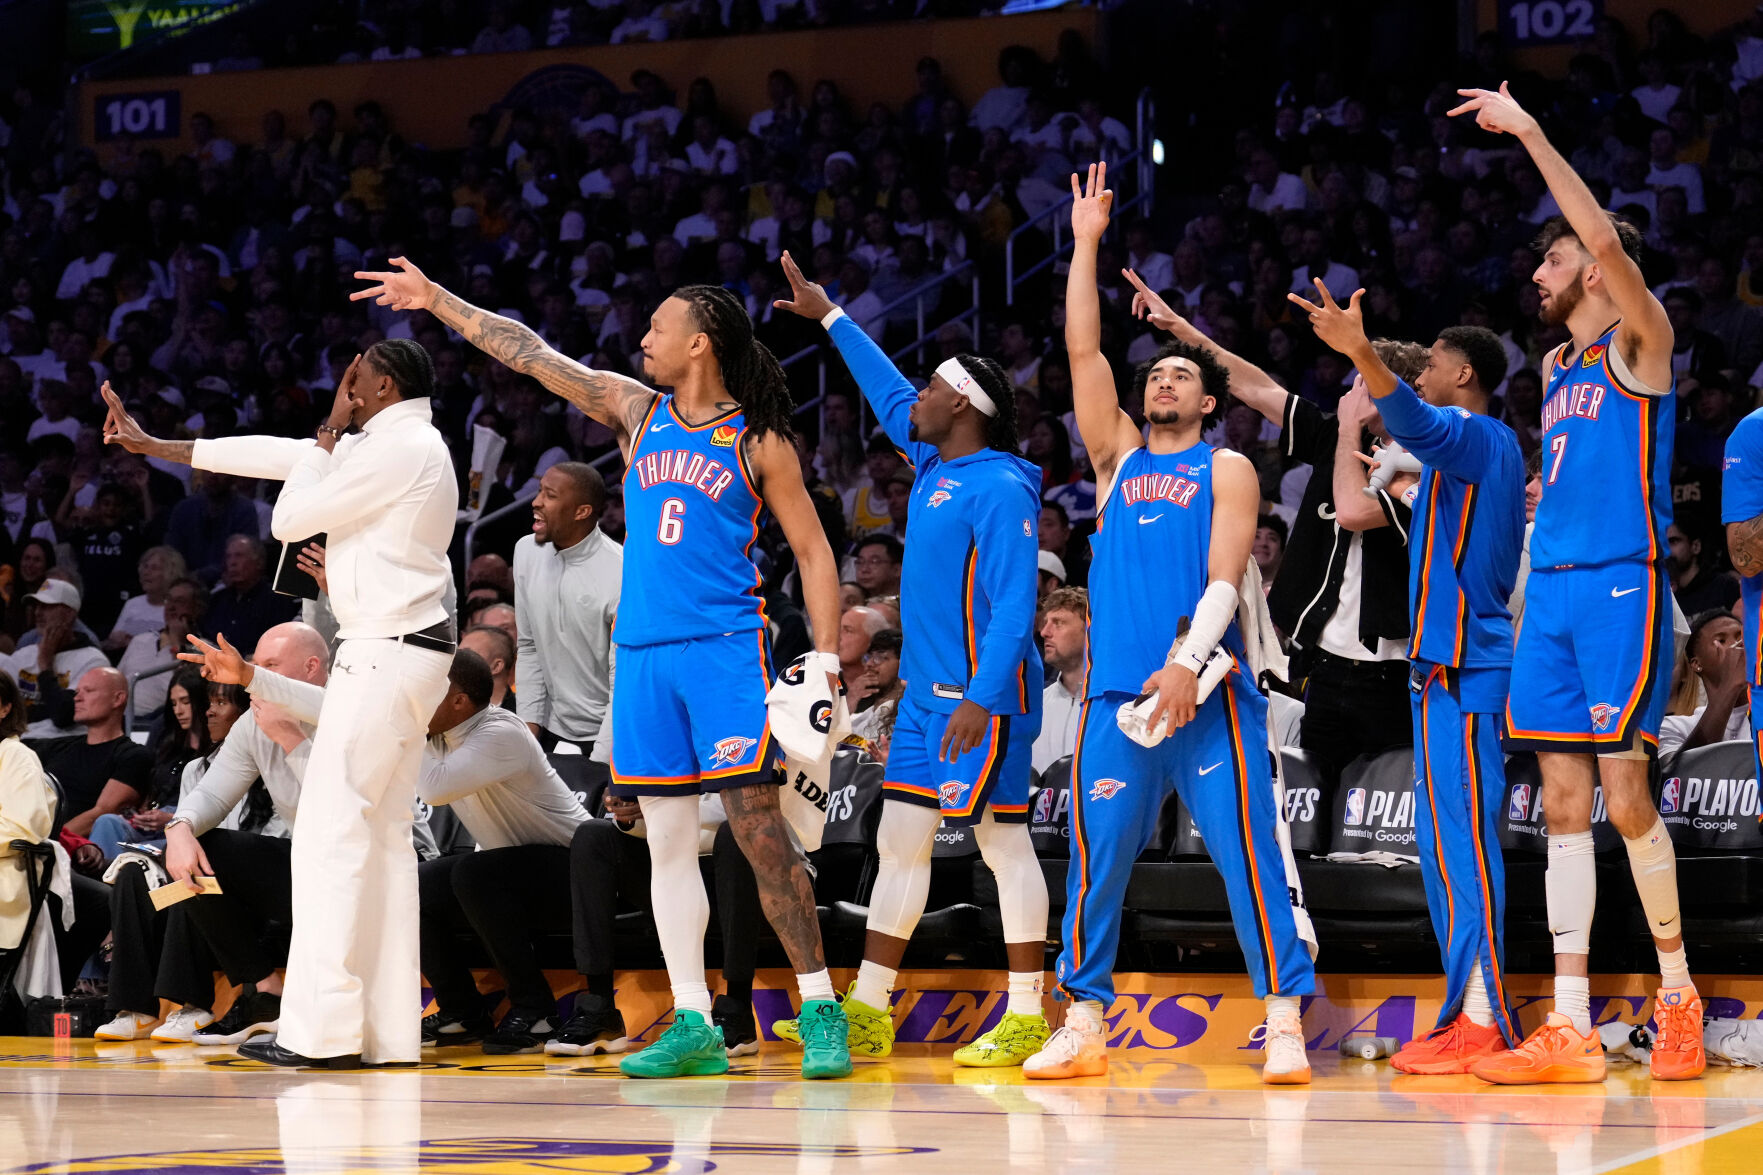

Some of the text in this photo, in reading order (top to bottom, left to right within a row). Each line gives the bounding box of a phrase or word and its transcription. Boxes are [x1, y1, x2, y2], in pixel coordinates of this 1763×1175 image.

[1510, 0, 1594, 38] 102
[106, 98, 166, 134] 101
[635, 449, 735, 503] THUNDER
[1547, 432, 1568, 486] 7
[1120, 472, 1201, 509] THUNDER
[657, 497, 687, 546] 6
[1375, 829, 1416, 845] Google
[1692, 817, 1737, 833] Google
